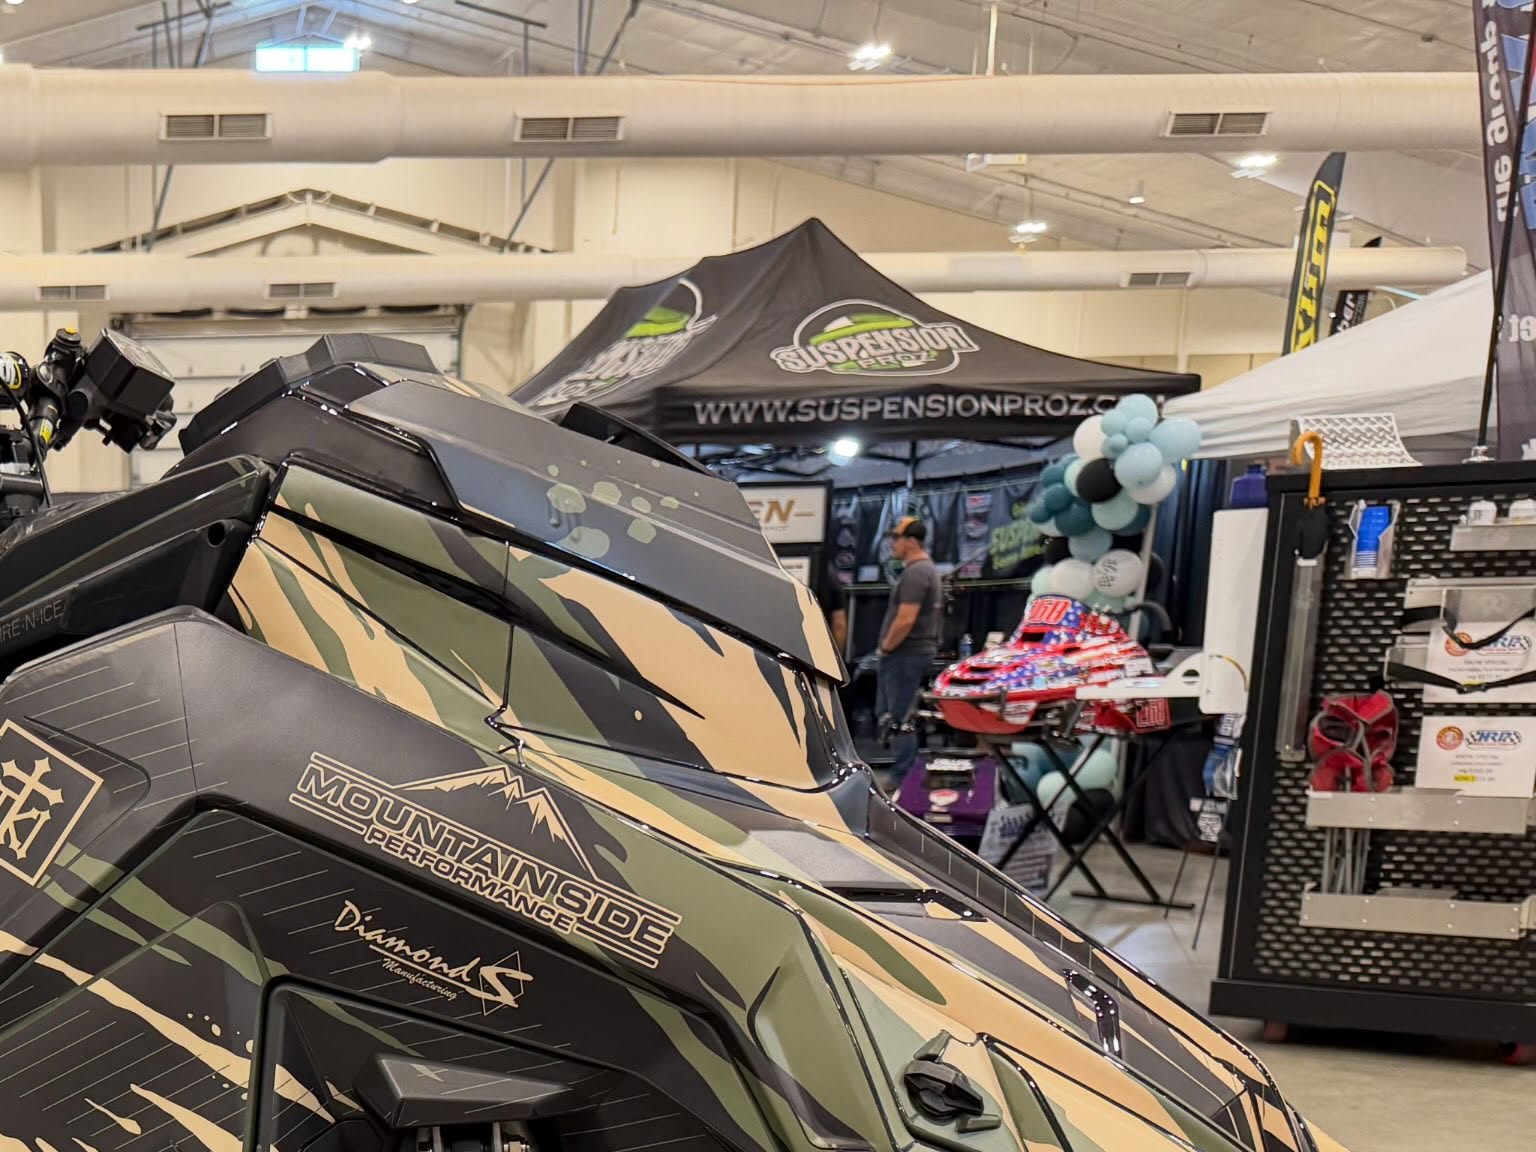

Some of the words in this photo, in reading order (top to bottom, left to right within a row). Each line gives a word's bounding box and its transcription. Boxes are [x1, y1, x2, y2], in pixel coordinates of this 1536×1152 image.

[776, 326, 964, 370] SUSPENSION
[694, 394, 1124, 425] WWW.SUSPENSIONPROZ.C
[296, 763, 562, 905] MOUNTAIN
[559, 880, 676, 956] SIDE
[364, 827, 578, 935] PERFORMANCE
[334, 899, 481, 982] Diamond
[381, 956, 458, 1001] Manufacturing
